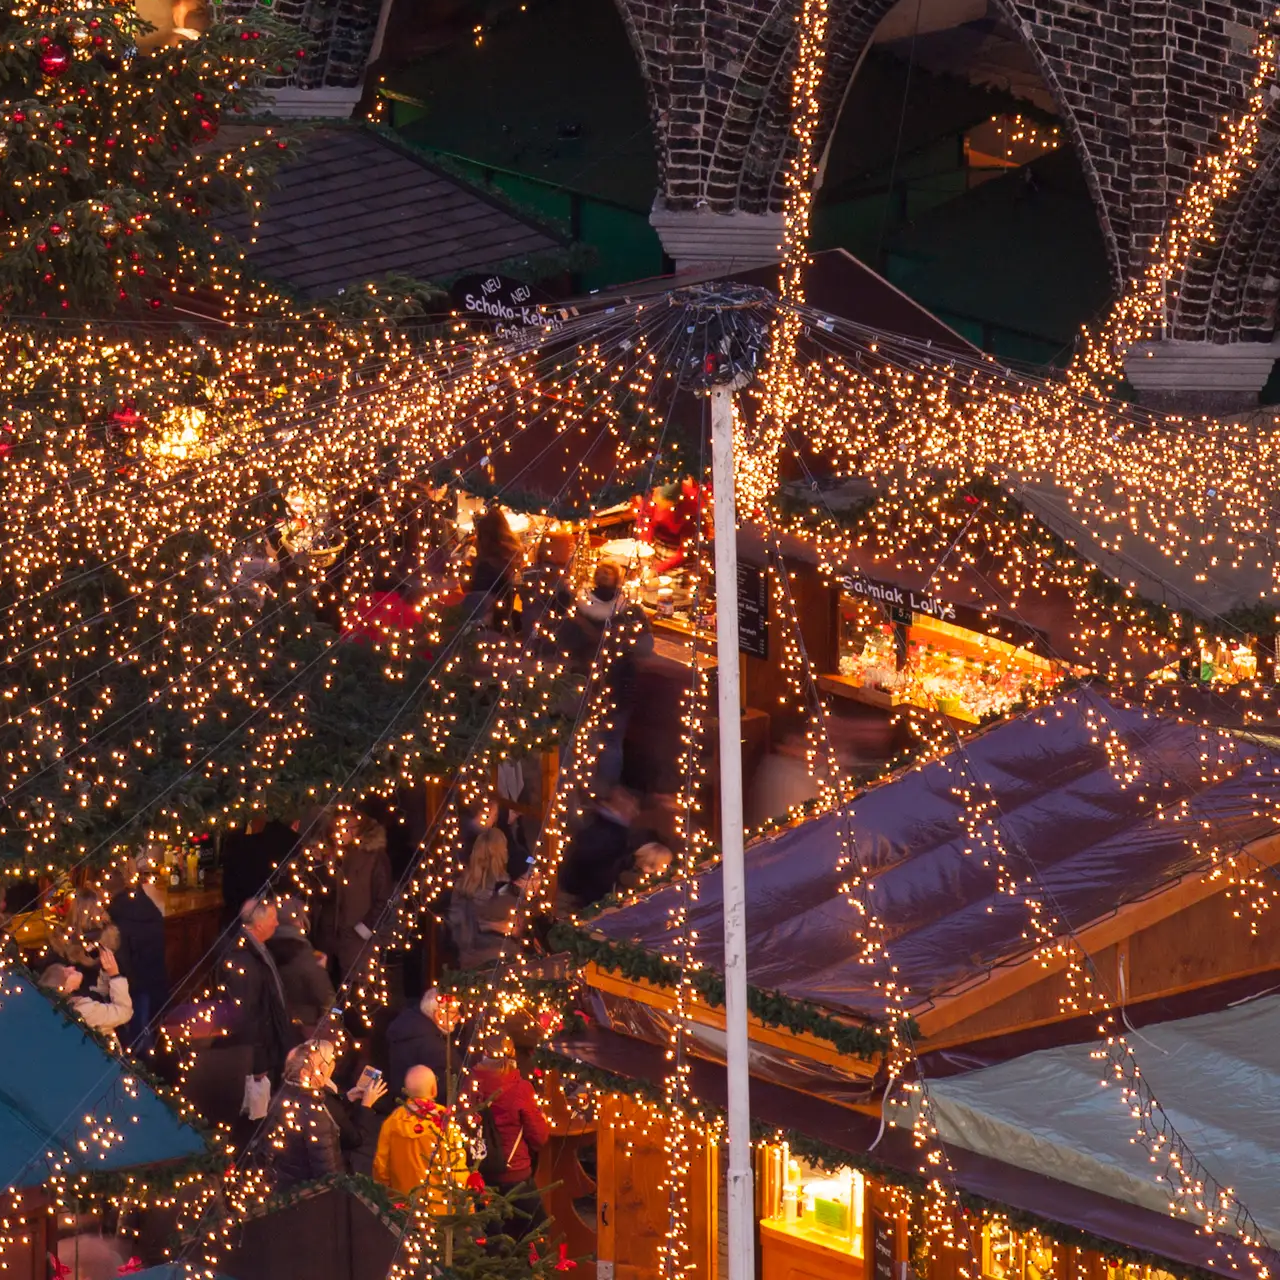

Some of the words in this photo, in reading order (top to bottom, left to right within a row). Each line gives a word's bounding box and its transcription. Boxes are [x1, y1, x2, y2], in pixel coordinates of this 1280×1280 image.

[481, 276, 502, 296] NEU
[510, 285, 531, 305] NEU
[910, 593, 956, 620] Lollys
